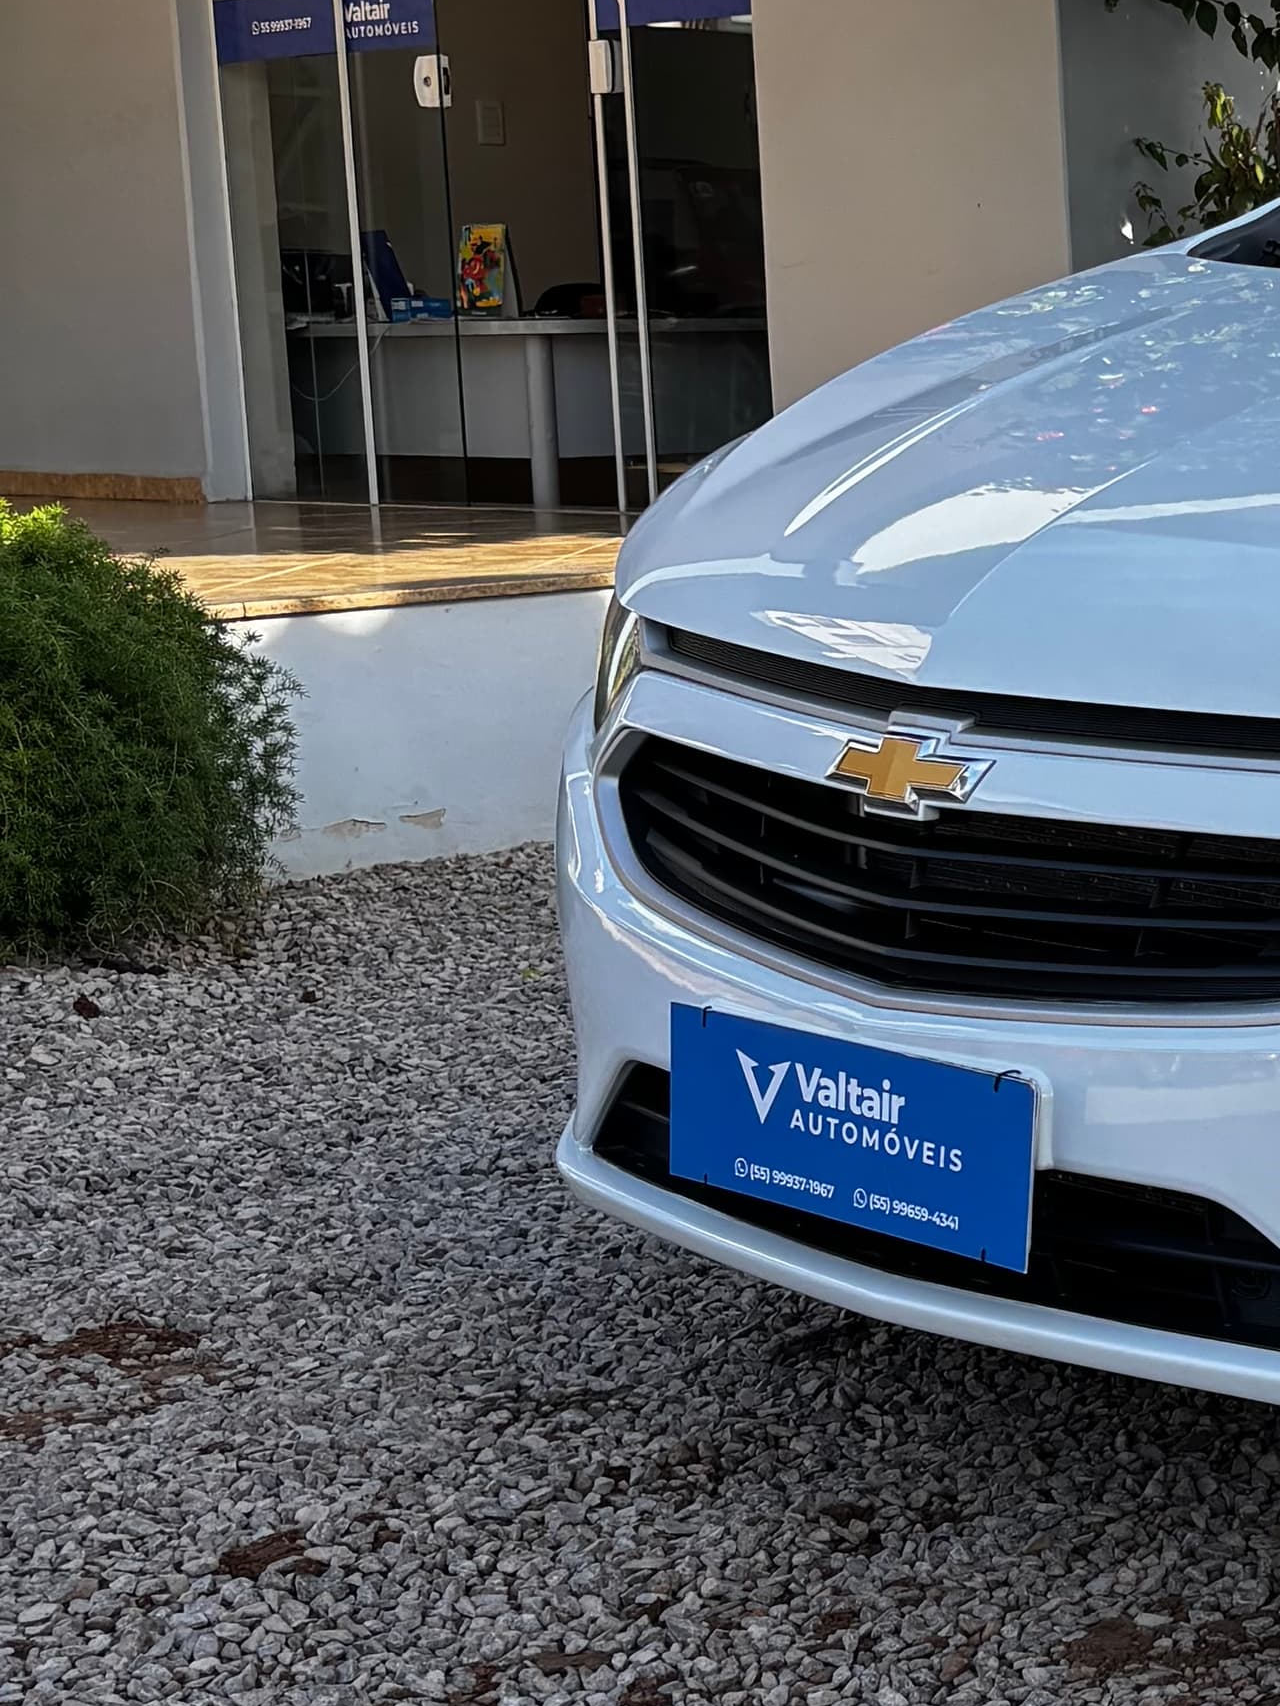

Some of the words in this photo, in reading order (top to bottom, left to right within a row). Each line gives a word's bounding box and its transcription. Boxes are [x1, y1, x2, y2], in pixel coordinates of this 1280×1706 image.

[794, 1062, 906, 1125] Valtair
[789, 1108, 963, 1173] AUTOMÓVEIS
[750, 1163, 770, 1185] (55)
[772, 1169, 835, 1199] 99937-1967
[869, 1193, 891, 1216] (55)
[892, 1199, 960, 1231] 99659-4341
